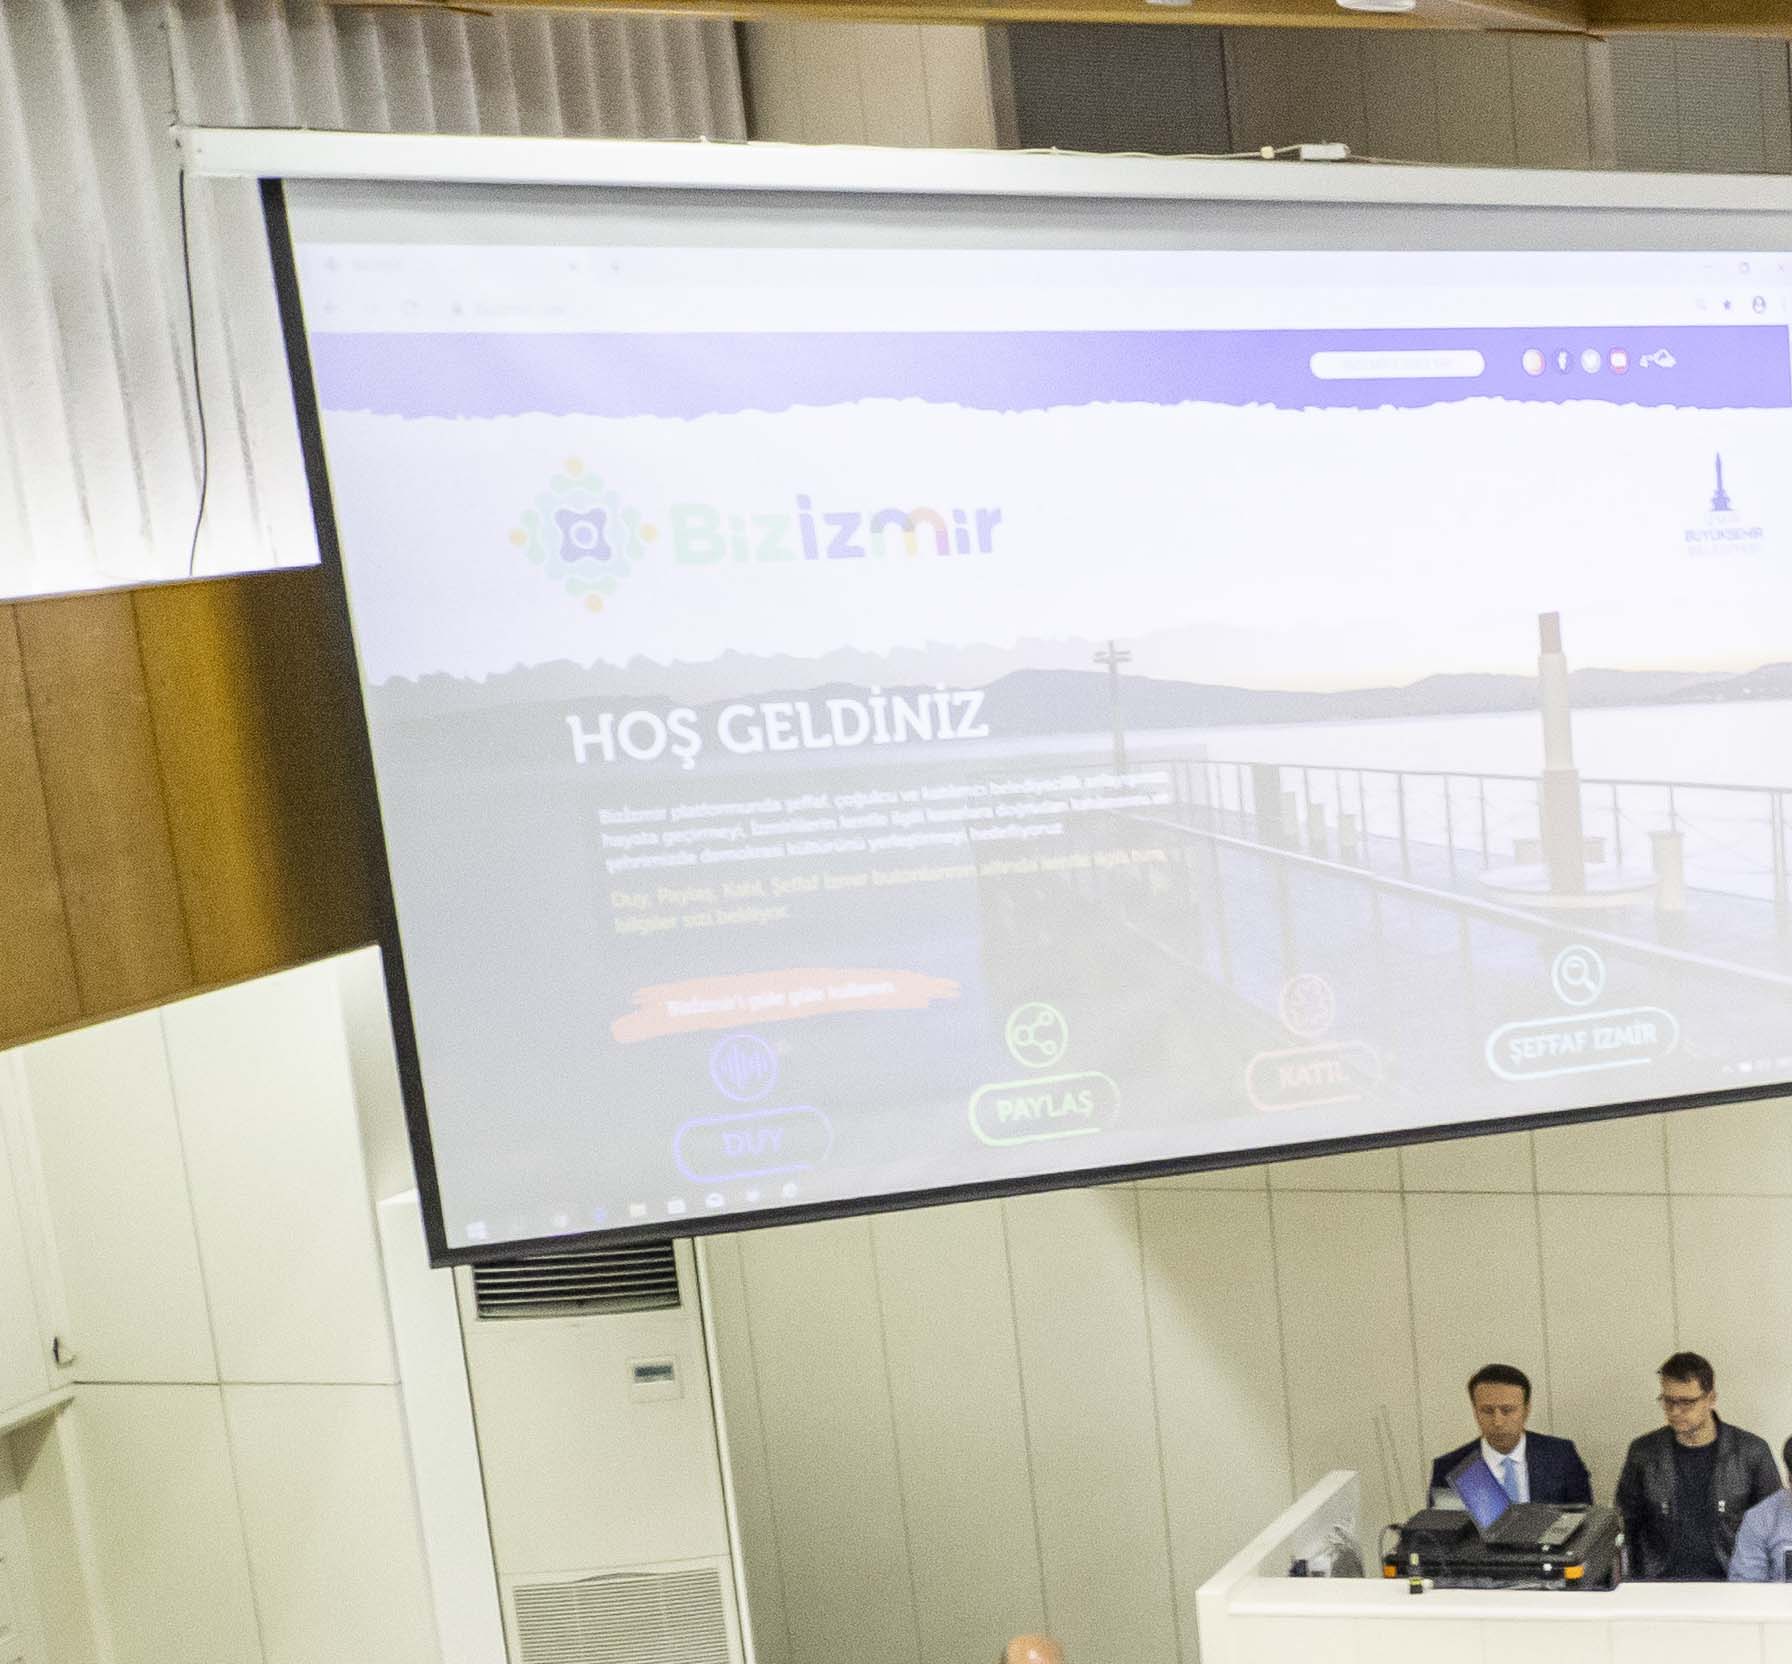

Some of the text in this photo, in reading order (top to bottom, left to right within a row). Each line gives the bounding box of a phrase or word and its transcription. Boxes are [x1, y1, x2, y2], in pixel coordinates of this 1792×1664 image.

[668, 493, 1003, 568] Bizizmir
[565, 682, 990, 771] HOŞ GELDİNİZ
[1509, 1020, 1658, 1066] ŞEFFAF İZMİR
[996, 1090, 1094, 1126] PAYLAŞ
